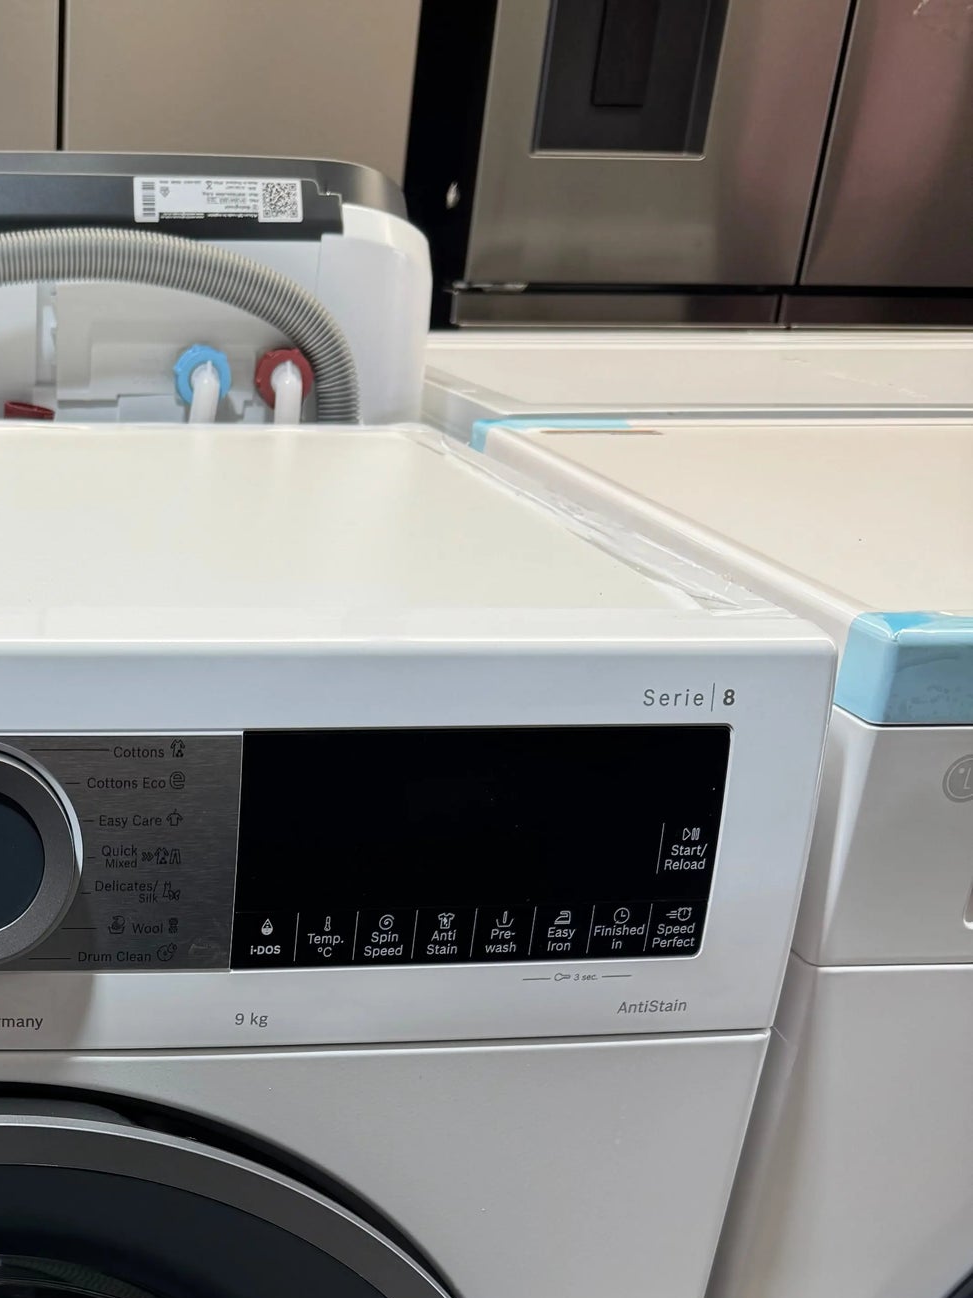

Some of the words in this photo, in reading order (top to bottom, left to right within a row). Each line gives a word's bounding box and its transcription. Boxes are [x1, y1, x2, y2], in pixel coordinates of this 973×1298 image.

[643, 688, 704, 707] Serie
[723, 689, 735, 706] 8
[113, 746, 165, 758] Cottons
[87, 777, 138, 789] Cottons
[143, 777, 166, 789] Eco
[99, 815, 128, 828] Easy
[132, 814, 162, 826] Care
[101, 845, 137, 857] Quick
[671, 844, 708, 857] Start/
[105, 858, 137, 868] Mixed
[664, 859, 705, 871] Reload
[95, 880, 158, 892] Delicates/
[138, 893, 158, 903] Silk
[132, 923, 163, 934] Wool
[490, 929, 515, 940] Pre-
[547, 927, 575, 940] Easy
[594, 924, 645, 937] Finished
[657, 923, 695, 936] Speed
[308, 933, 344, 946] Temp.
[371, 931, 399, 944] Spin
[431, 930, 456, 941] Anti
[485, 943, 517, 953] wash
[547, 942, 571, 951] Iron
[612, 940, 622, 950] in
[652, 937, 695, 948] Perfect
[317, 947, 332, 958] °C
[364, 945, 404, 957] Speed
[426, 944, 458, 955] Stain
[78, 951, 112, 962] Drum
[117, 951, 151, 962] Clean
[617, 1000, 687, 1015] AntiStain
[235, 1013, 245, 1026] 9
[250, 1012, 268, 1028] kg
